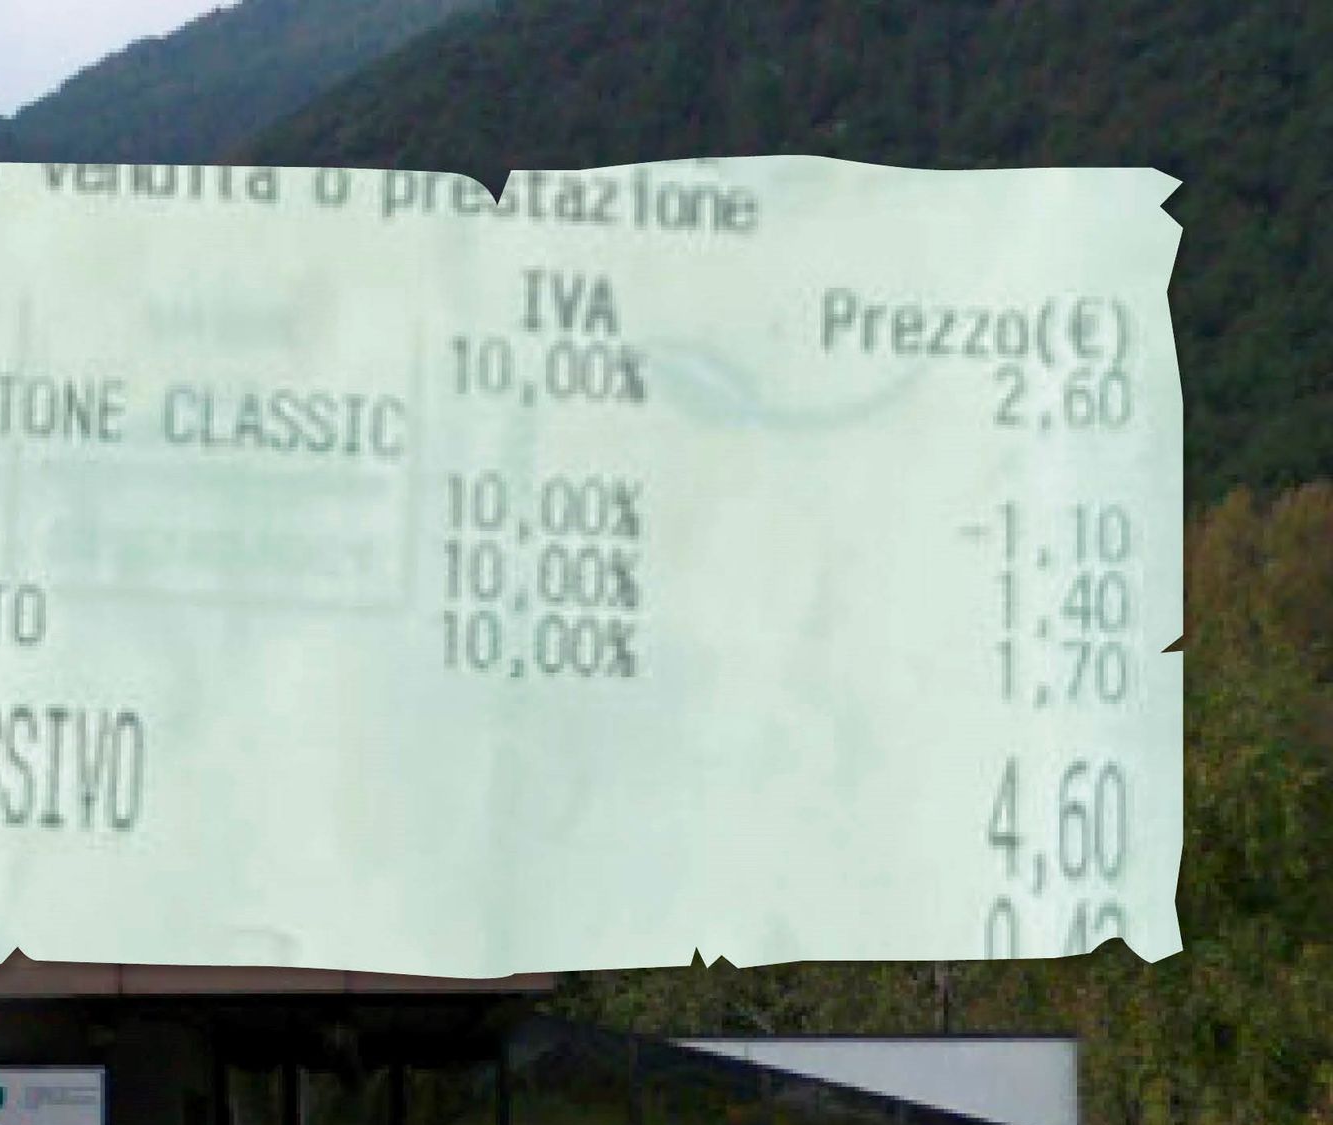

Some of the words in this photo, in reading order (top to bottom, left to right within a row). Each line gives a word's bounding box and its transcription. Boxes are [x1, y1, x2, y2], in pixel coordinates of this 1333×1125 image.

[522, 268, 620, 335] IVA
[820, 287, 1133, 365] Prezzo(€)
[163, 386, 405, 459] CLASSIC
[450, 335, 647, 406] 10,00%
[993, 367, 1133, 434] 2,60
[446, 472, 643, 544] 10,00%
[443, 540, 641, 612] 10,00%
[998, 571, 1131, 637] 1,40
[442, 609, 640, 678] 10,00%
[998, 639, 1130, 706] 1,70
[987, 755, 1128, 894] 4,60
